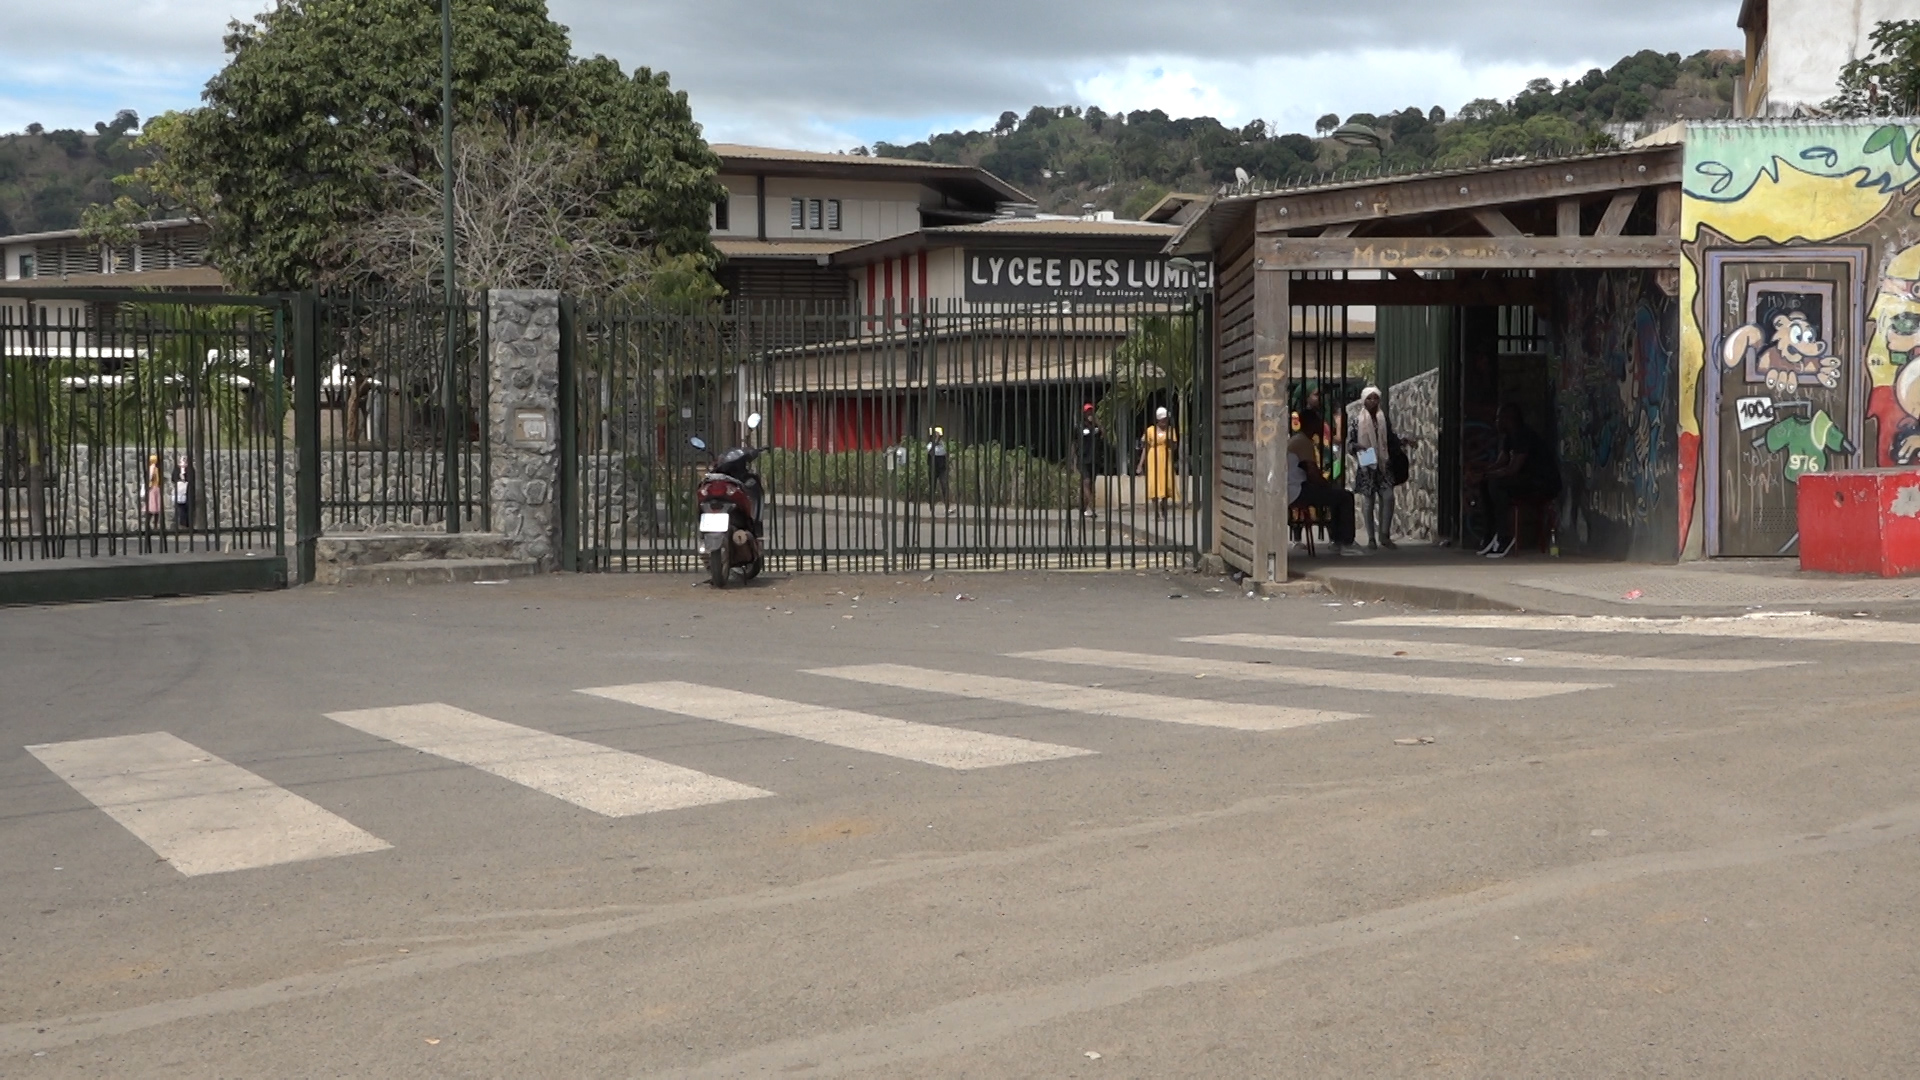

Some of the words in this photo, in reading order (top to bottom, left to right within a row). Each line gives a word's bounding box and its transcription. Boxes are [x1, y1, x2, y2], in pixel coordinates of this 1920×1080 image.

[971, 256, 1062, 287] LYCEE
[1069, 258, 1120, 287] DES
[1127, 258, 1214, 289] LUMIE
[1788, 454, 1820, 473] 976
